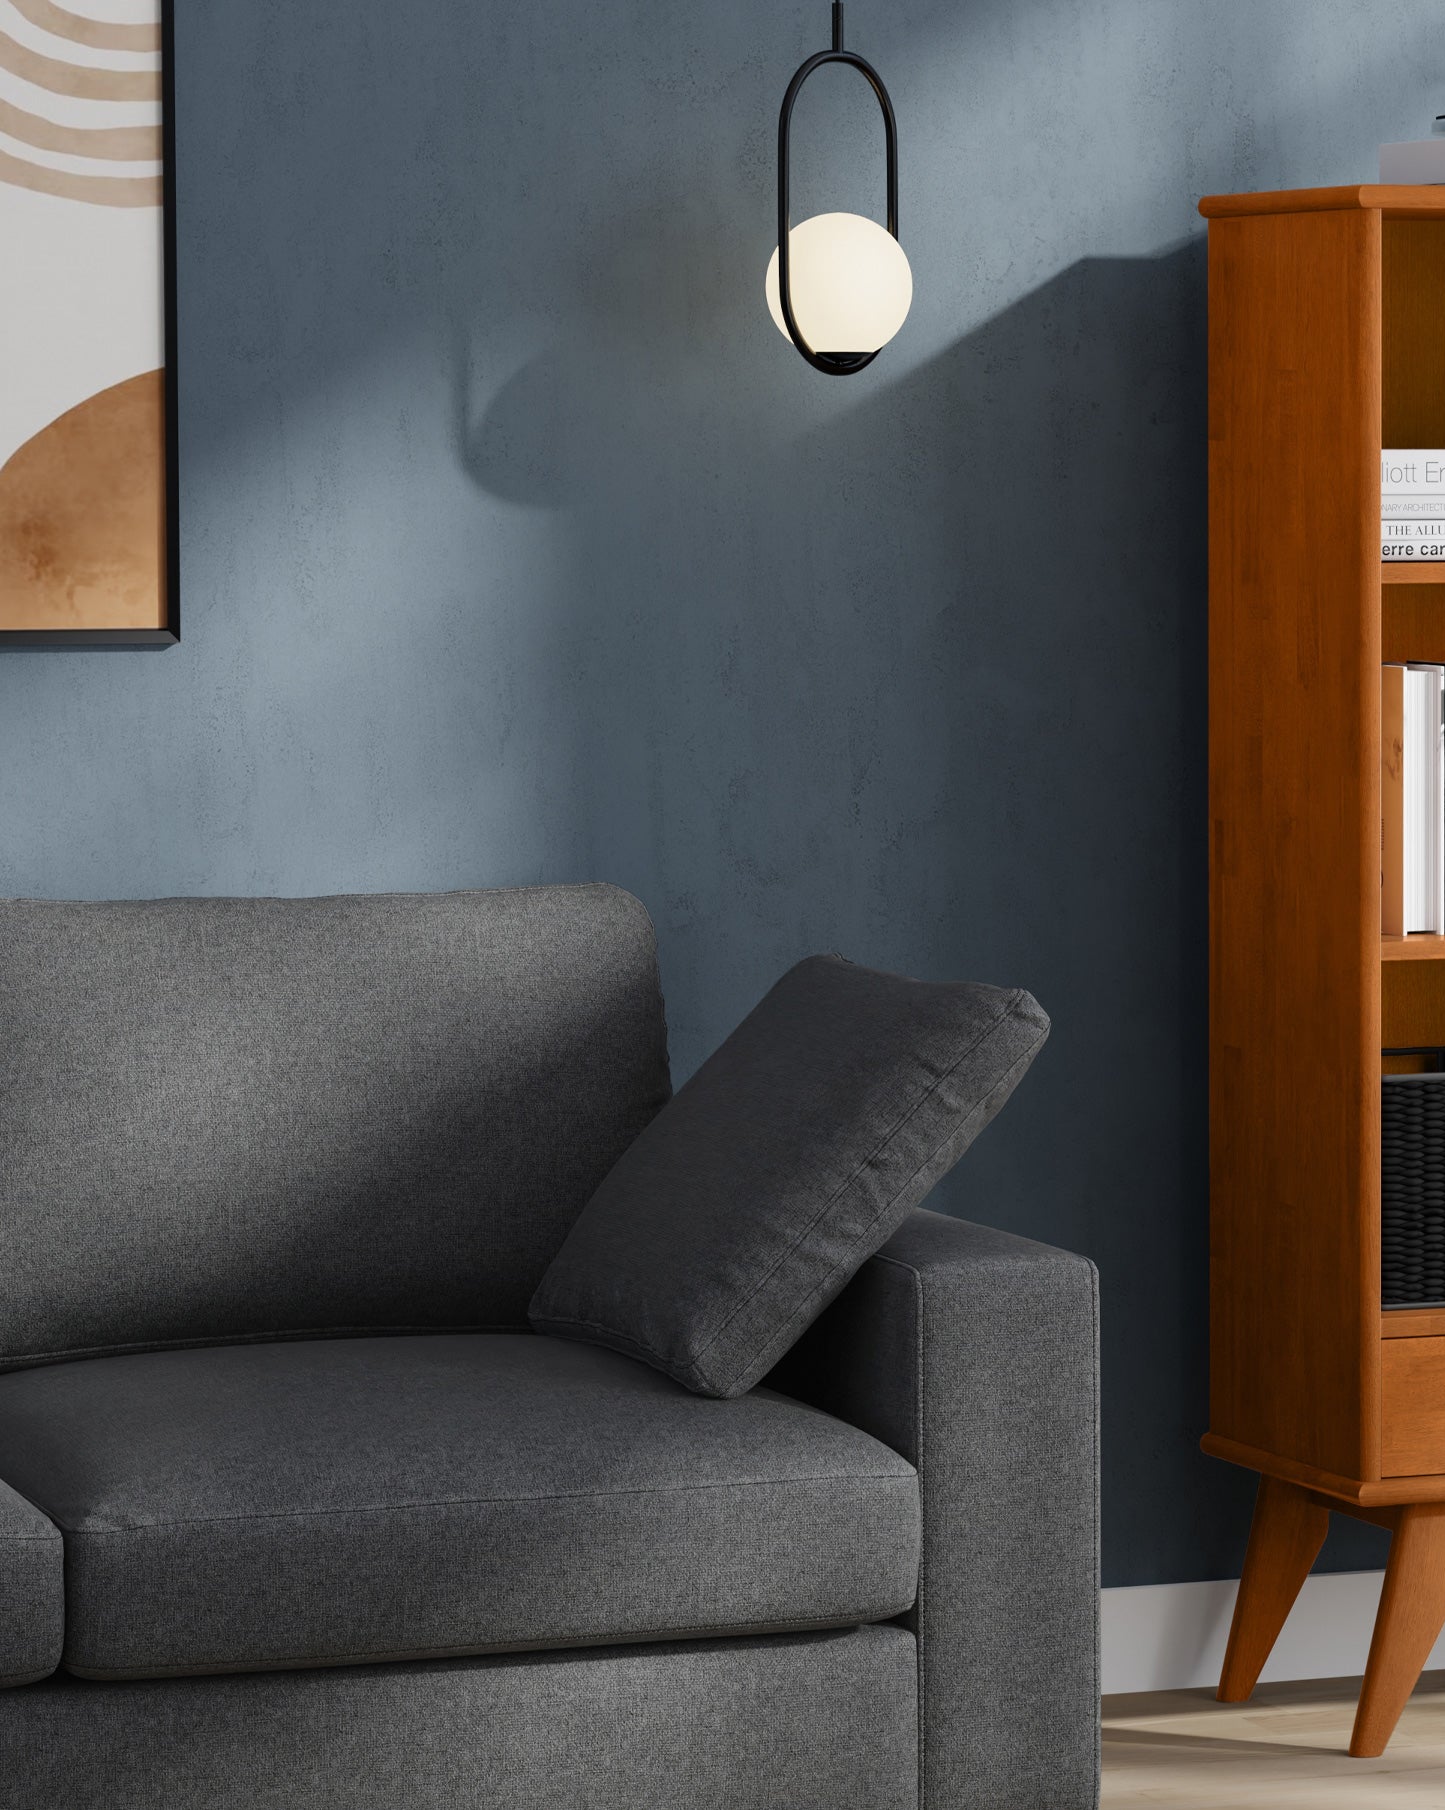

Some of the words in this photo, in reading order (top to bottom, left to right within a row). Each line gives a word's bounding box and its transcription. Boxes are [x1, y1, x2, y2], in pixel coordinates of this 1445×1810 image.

[1381, 461, 1418, 483] liott
[1381, 503, 1402, 513] NARY
[1386, 525, 1412, 536] THE
[1382, 544, 1414, 556] erre
